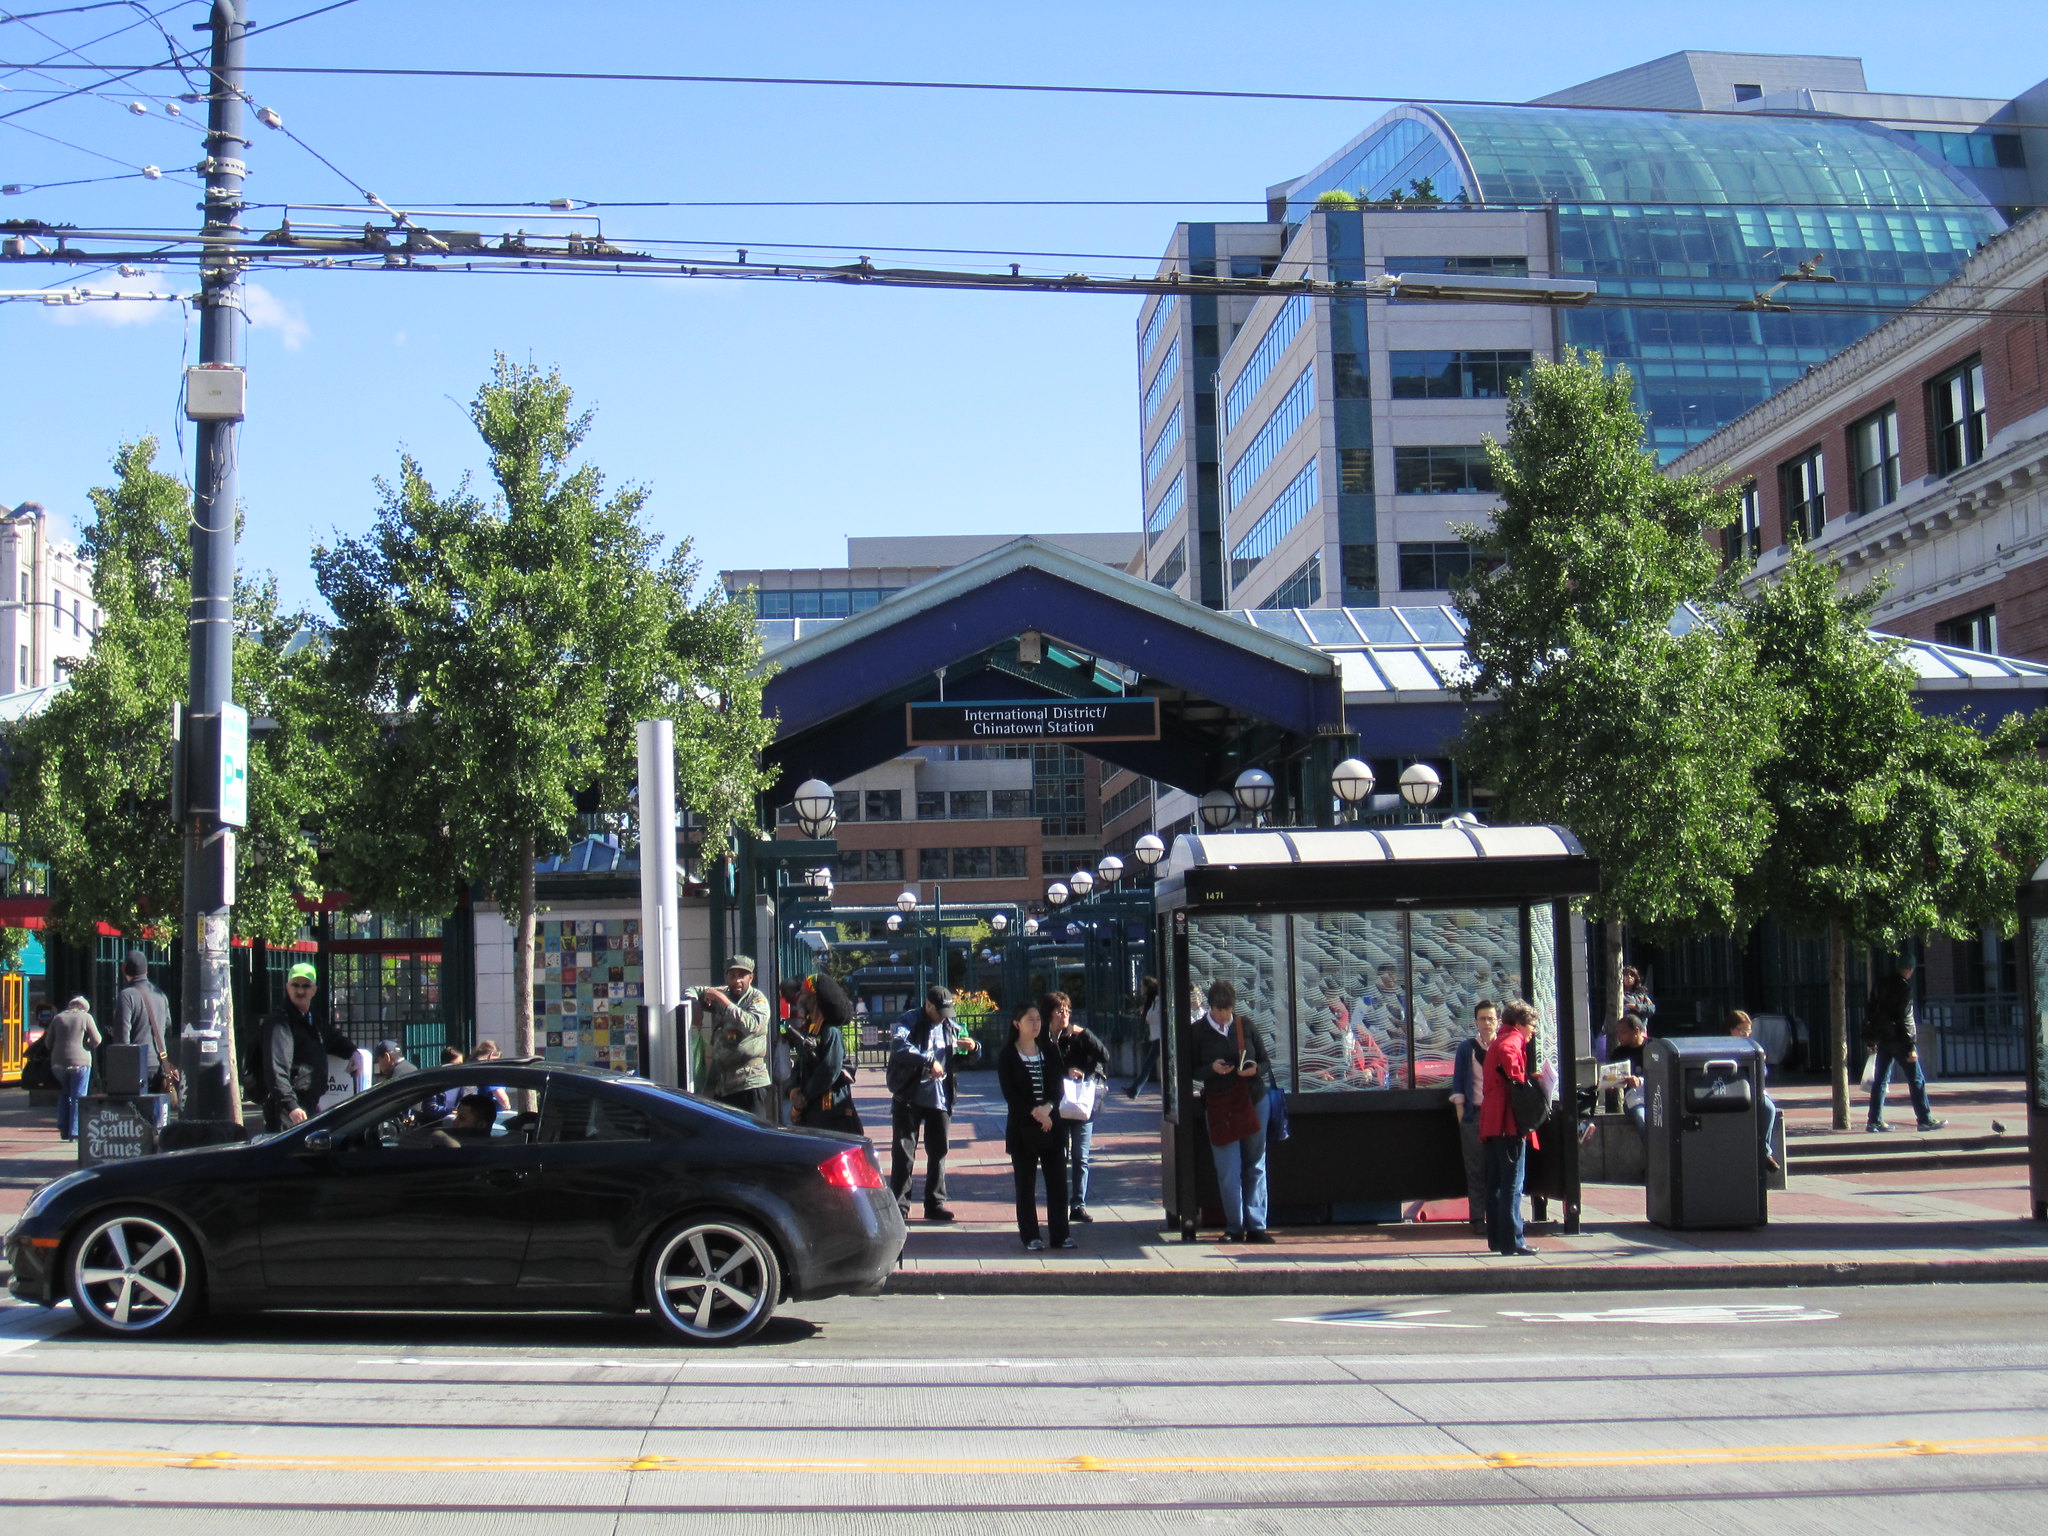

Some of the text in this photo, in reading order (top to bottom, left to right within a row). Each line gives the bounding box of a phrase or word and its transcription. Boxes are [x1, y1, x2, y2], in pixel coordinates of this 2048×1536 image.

[964, 706, 1107, 721] International District/
[973, 721, 1095, 735] Chinatown Station
[1206, 891, 1224, 900] 1471
[100, 1110, 120, 1122] The
[87, 1119, 144, 1139] Seattle
[88, 1139, 142, 1158] Times
